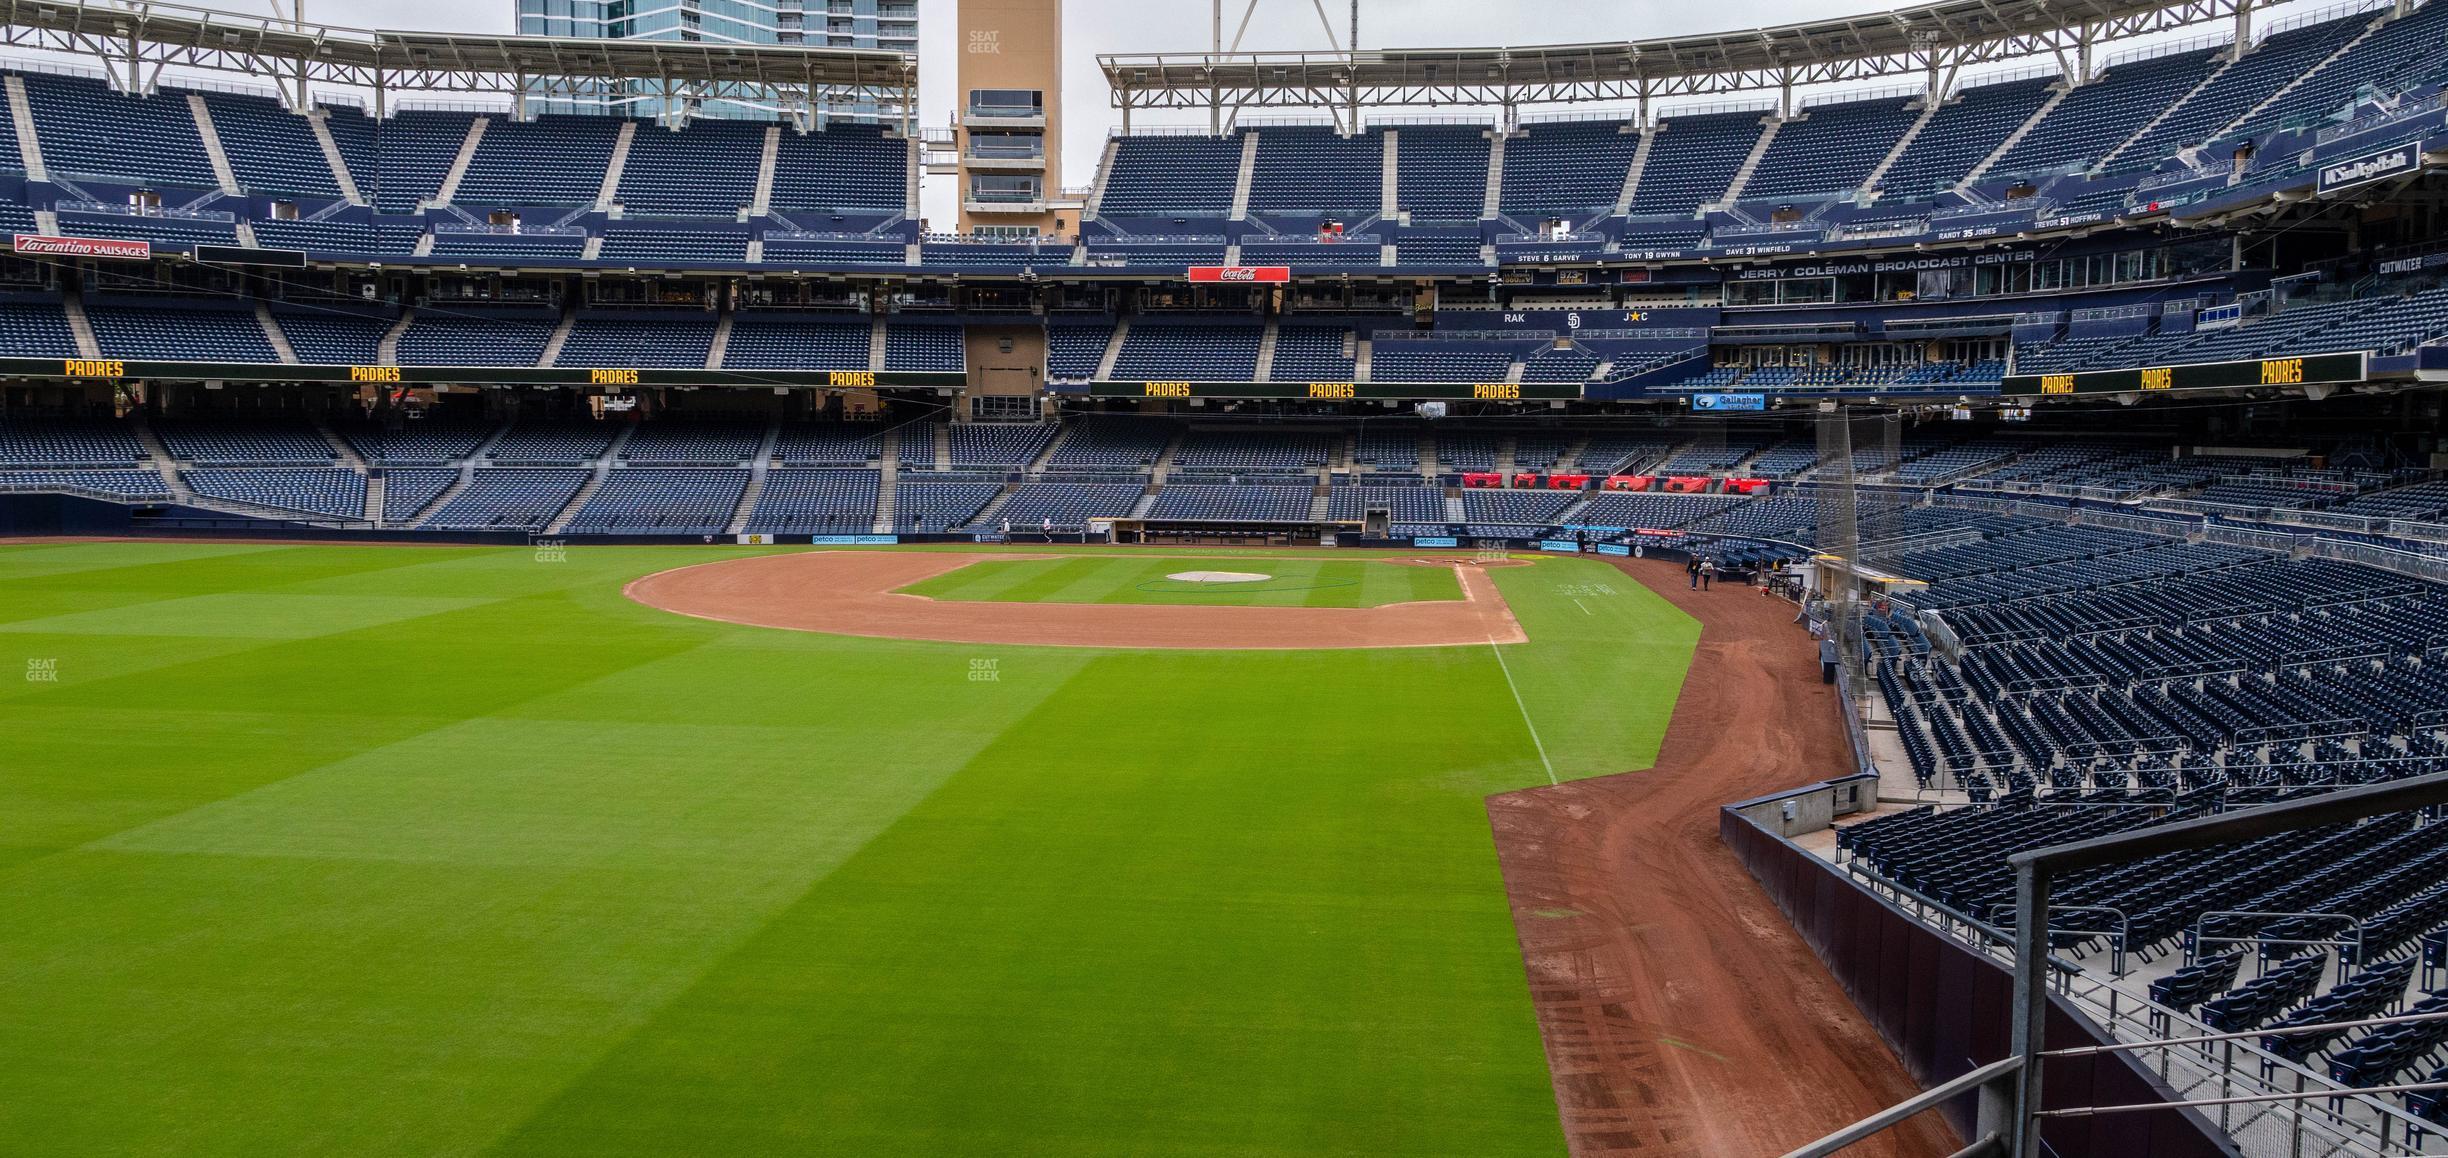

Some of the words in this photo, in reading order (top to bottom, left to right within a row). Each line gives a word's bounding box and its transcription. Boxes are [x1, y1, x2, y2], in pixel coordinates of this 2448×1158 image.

[2034, 219, 2059, 230] TREVOR
[2060, 217, 2069, 226] 51
[2070, 214, 2101, 224] HOFFMAN
[1938, 231, 1960, 240] RANDY
[1963, 229, 1973, 238] 35
[1975, 227, 1997, 236] JONES
[18, 237, 91, 254] Tarantino
[93, 245, 147, 257] SAUSAGES
[1726, 248, 1744, 256] DAVE
[1746, 247, 1756, 255] 31
[1757, 245, 1790, 254] WINFIELD
[1552, 254, 1580, 262] GARVEY
[1624, 252, 1642, 260] TONY
[1644, 251, 1654, 259] 19
[1739, 268, 1788, 279] JERRY
[1794, 263, 1868, 277] COLEMAN
[1874, 256, 1969, 272] BROADCAST
[1975, 250, 2034, 265] CENTER
[2379, 257, 2422, 274] CUTWATER
[1221, 268, 1256, 280] Coca-Cola
[1504, 313, 1525, 323] RAK
[65, 360, 124, 377] PADRES
[351, 366, 401, 381] PADRES
[2261, 359, 2303, 384] PADRES
[592, 369, 638, 384] PADRES
[830, 372, 875, 386] PADRES
[2141, 368, 2172, 390] PADRES
[1145, 382, 1190, 397] PADRES
[1309, 383, 1355, 398] PADRES
[1474, 384, 1520, 398] PADRES
[2041, 375, 2074, 394] PADRES
[813, 536, 833, 544] petco
[1542, 541, 1561, 549] petco
